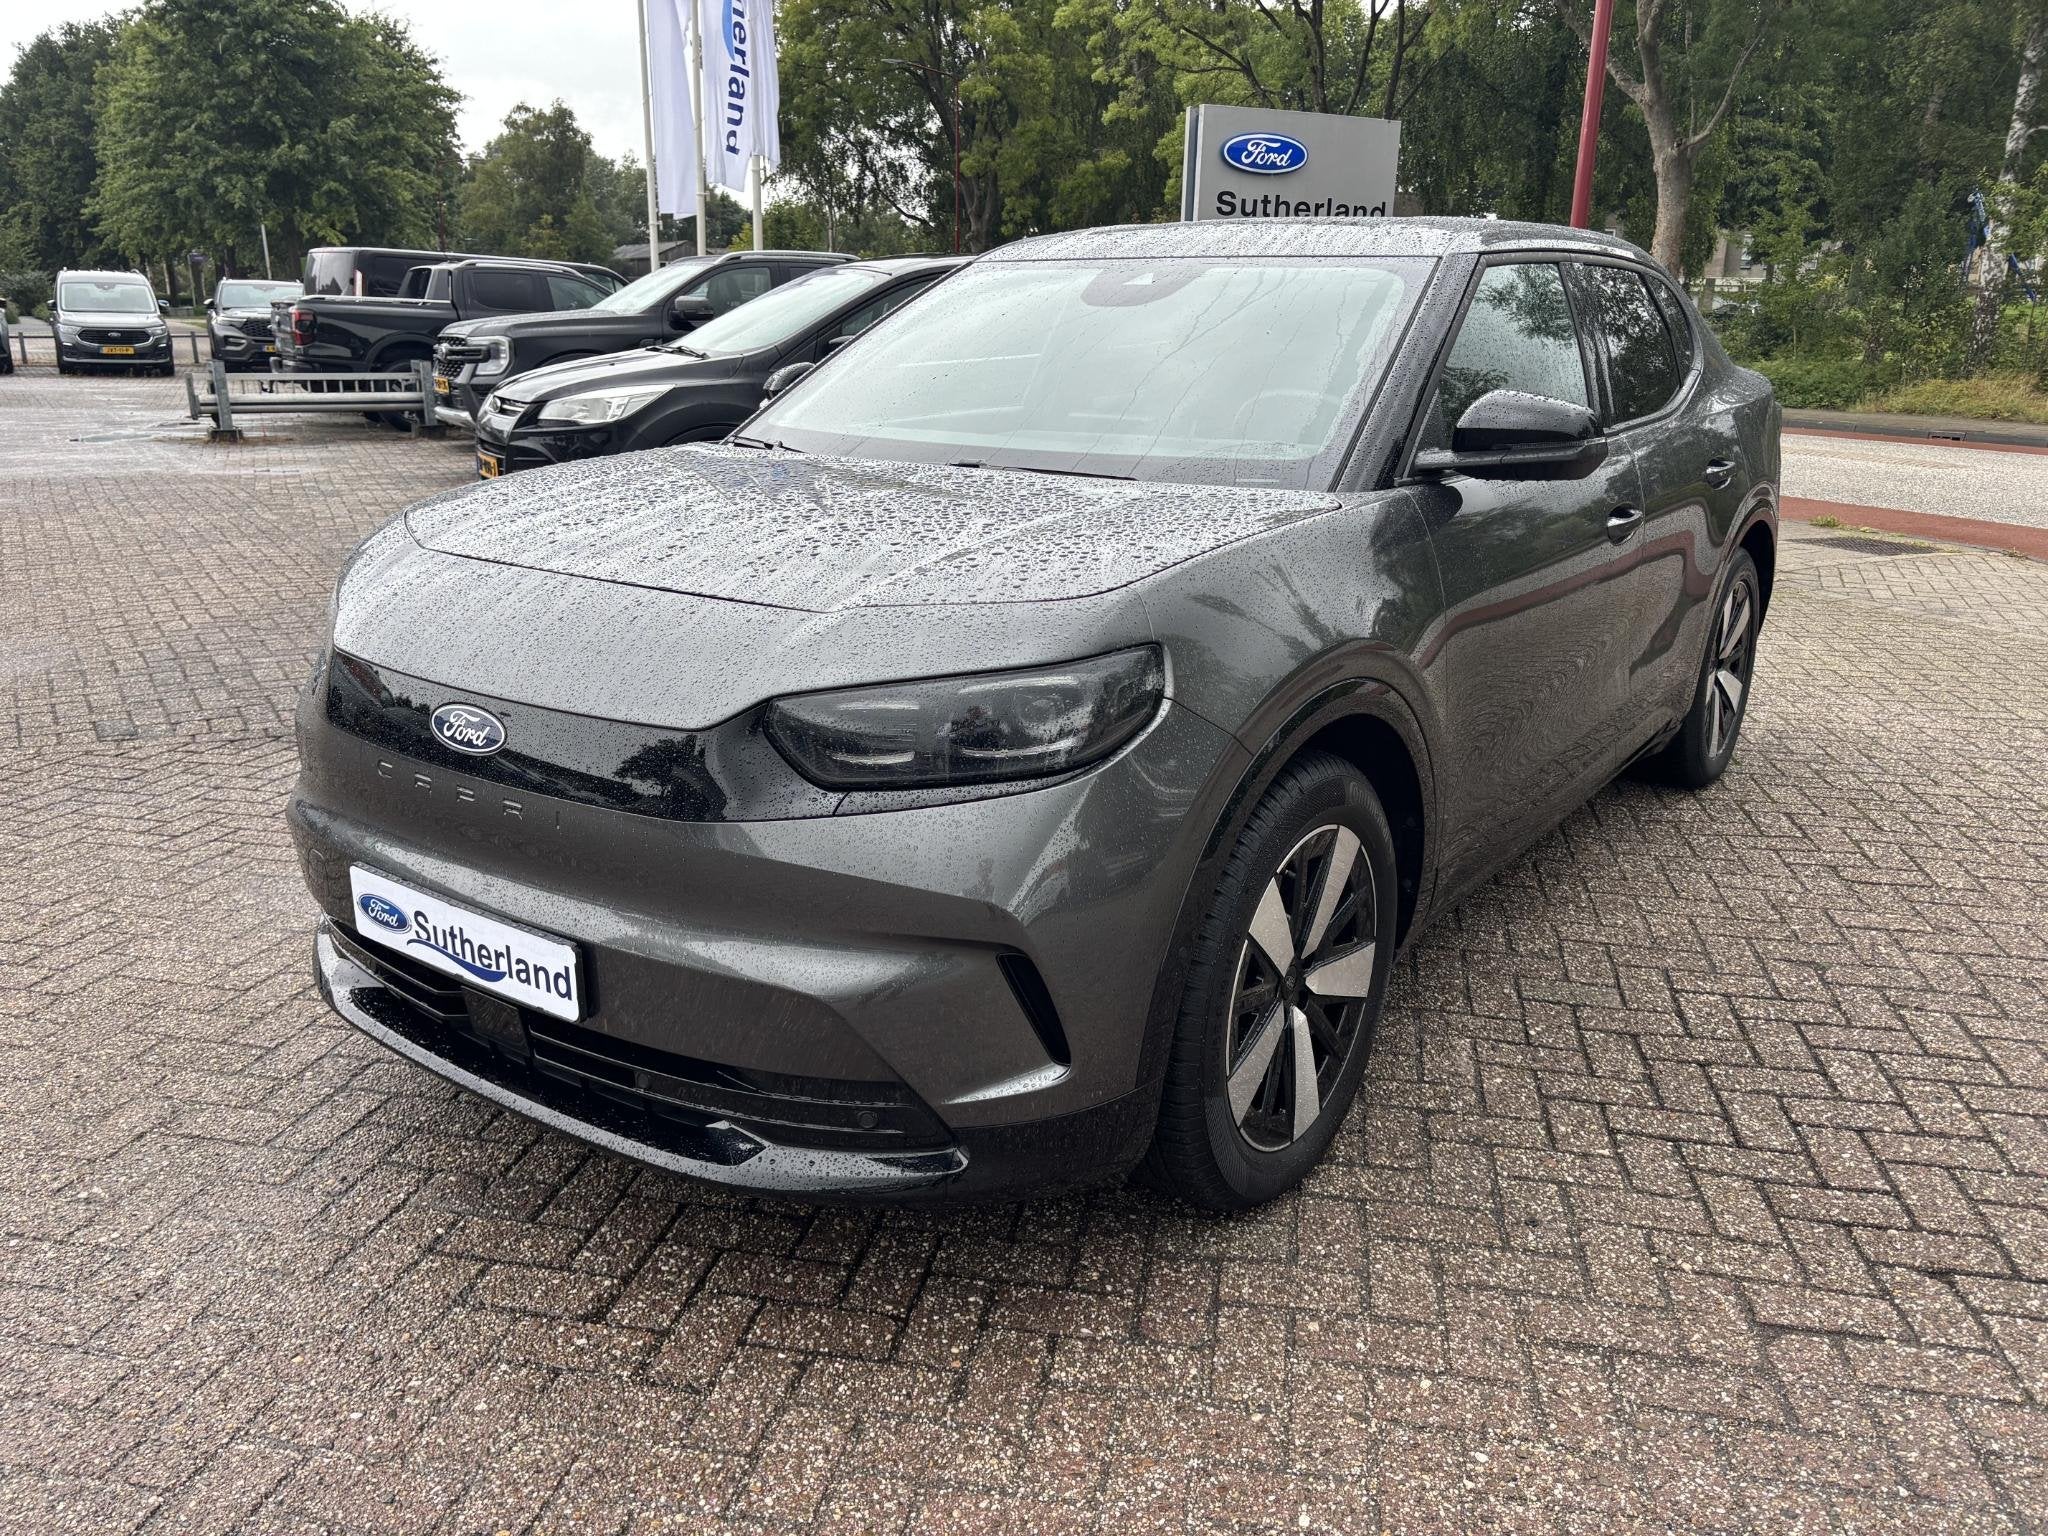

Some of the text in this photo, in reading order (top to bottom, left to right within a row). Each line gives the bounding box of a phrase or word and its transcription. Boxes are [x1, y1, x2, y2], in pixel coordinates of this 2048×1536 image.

[1241, 139, 1293, 167] Ford
[1216, 190, 1387, 218] Sutherland
[443, 710, 491, 747] Ford
[377, 758, 562, 831] CAPRI
[367, 897, 400, 929] Ford
[413, 910, 573, 1001] Sutherland
